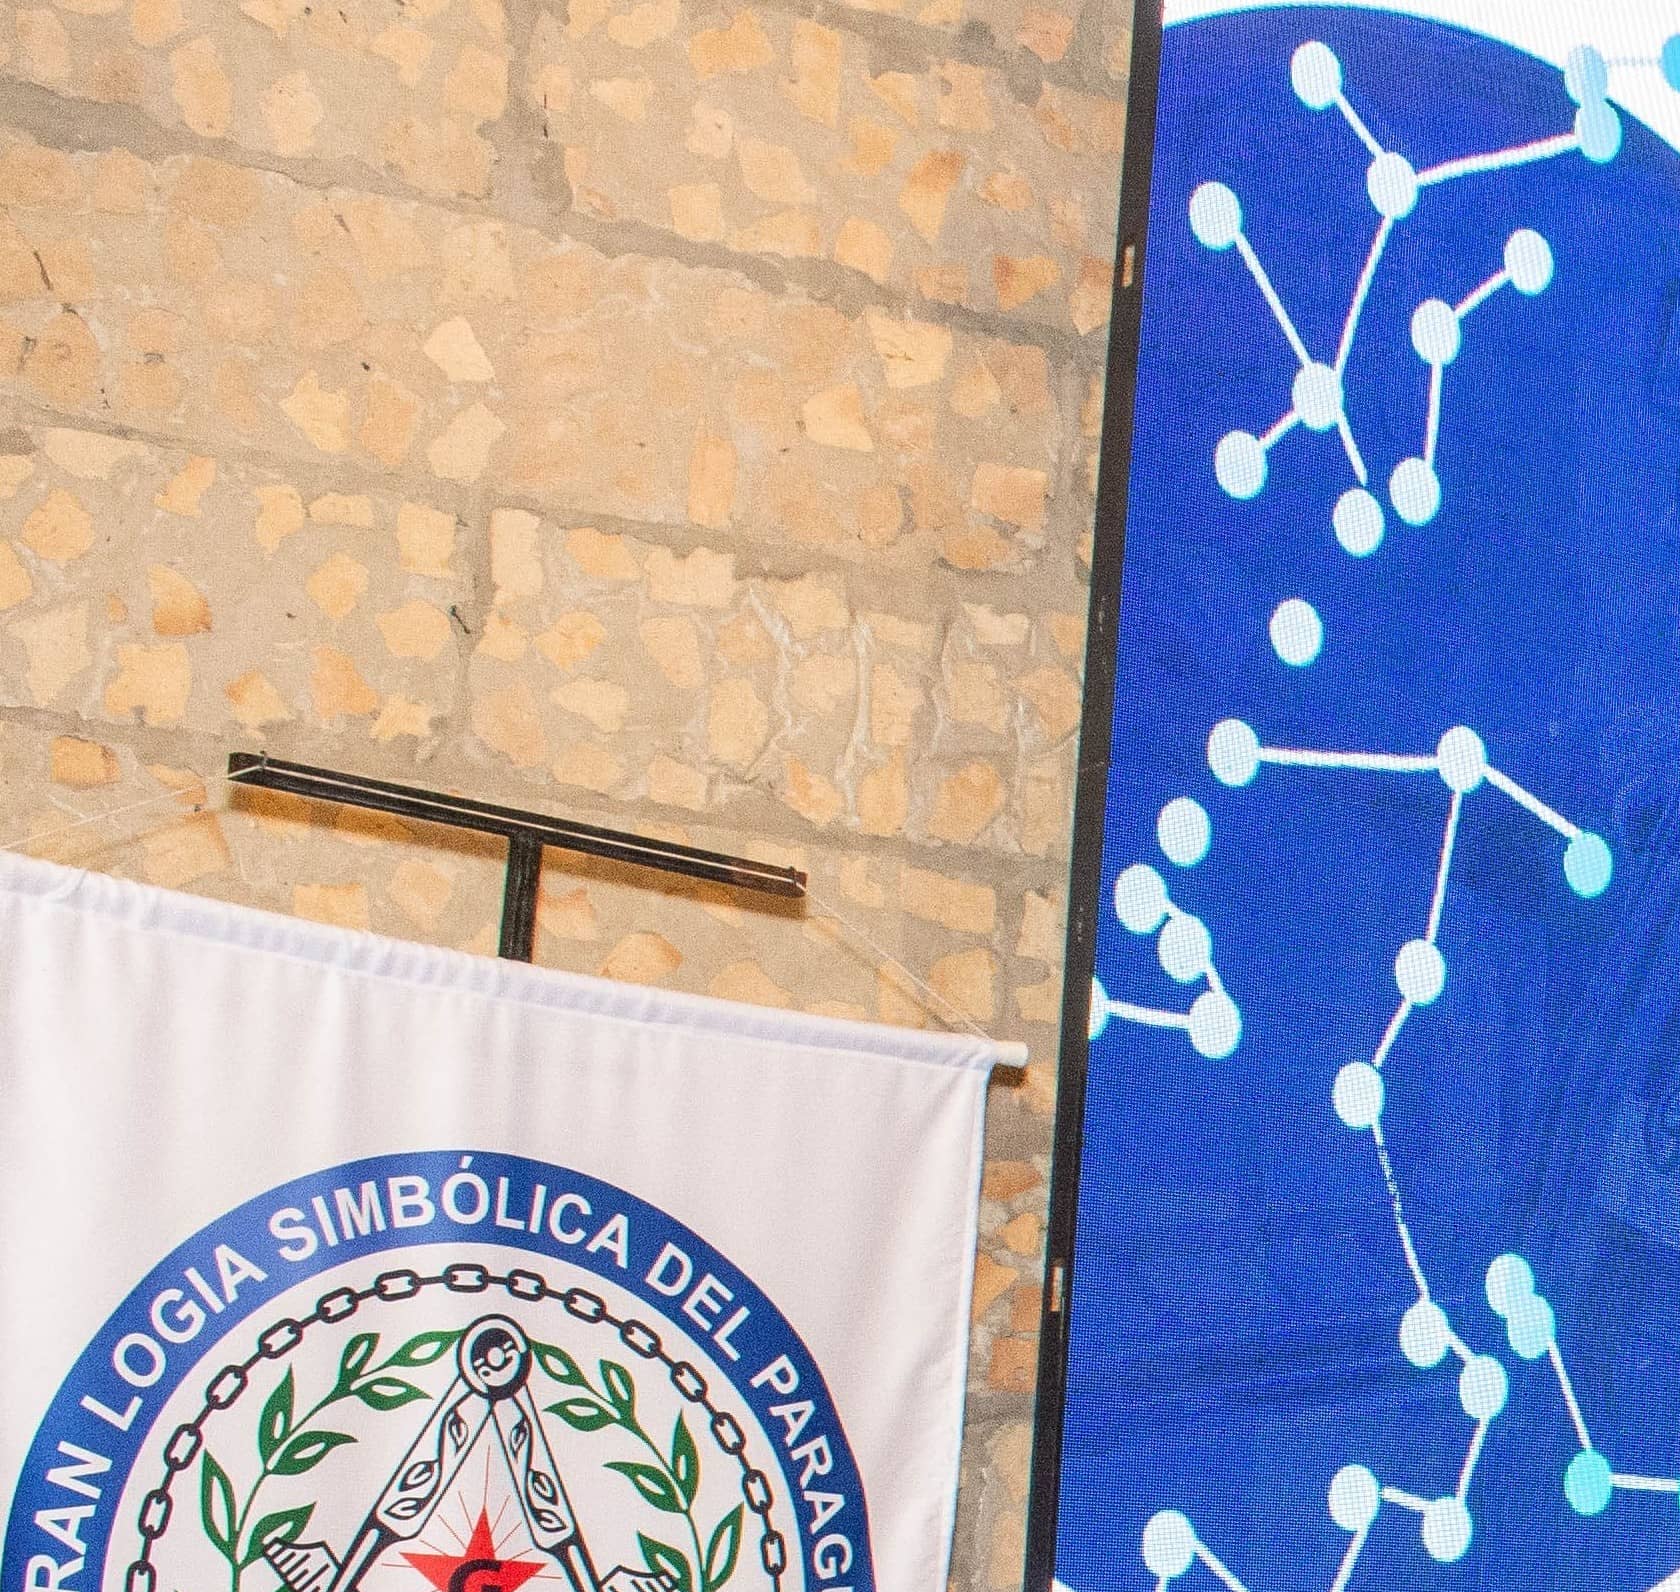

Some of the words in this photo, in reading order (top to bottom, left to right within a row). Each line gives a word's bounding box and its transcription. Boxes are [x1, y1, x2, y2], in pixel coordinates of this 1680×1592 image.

[81, 1244, 270, 1429] LOGIA
[268, 1156, 632, 1268] SIMBÓLICA
[647, 1242, 752, 1363] DEL
